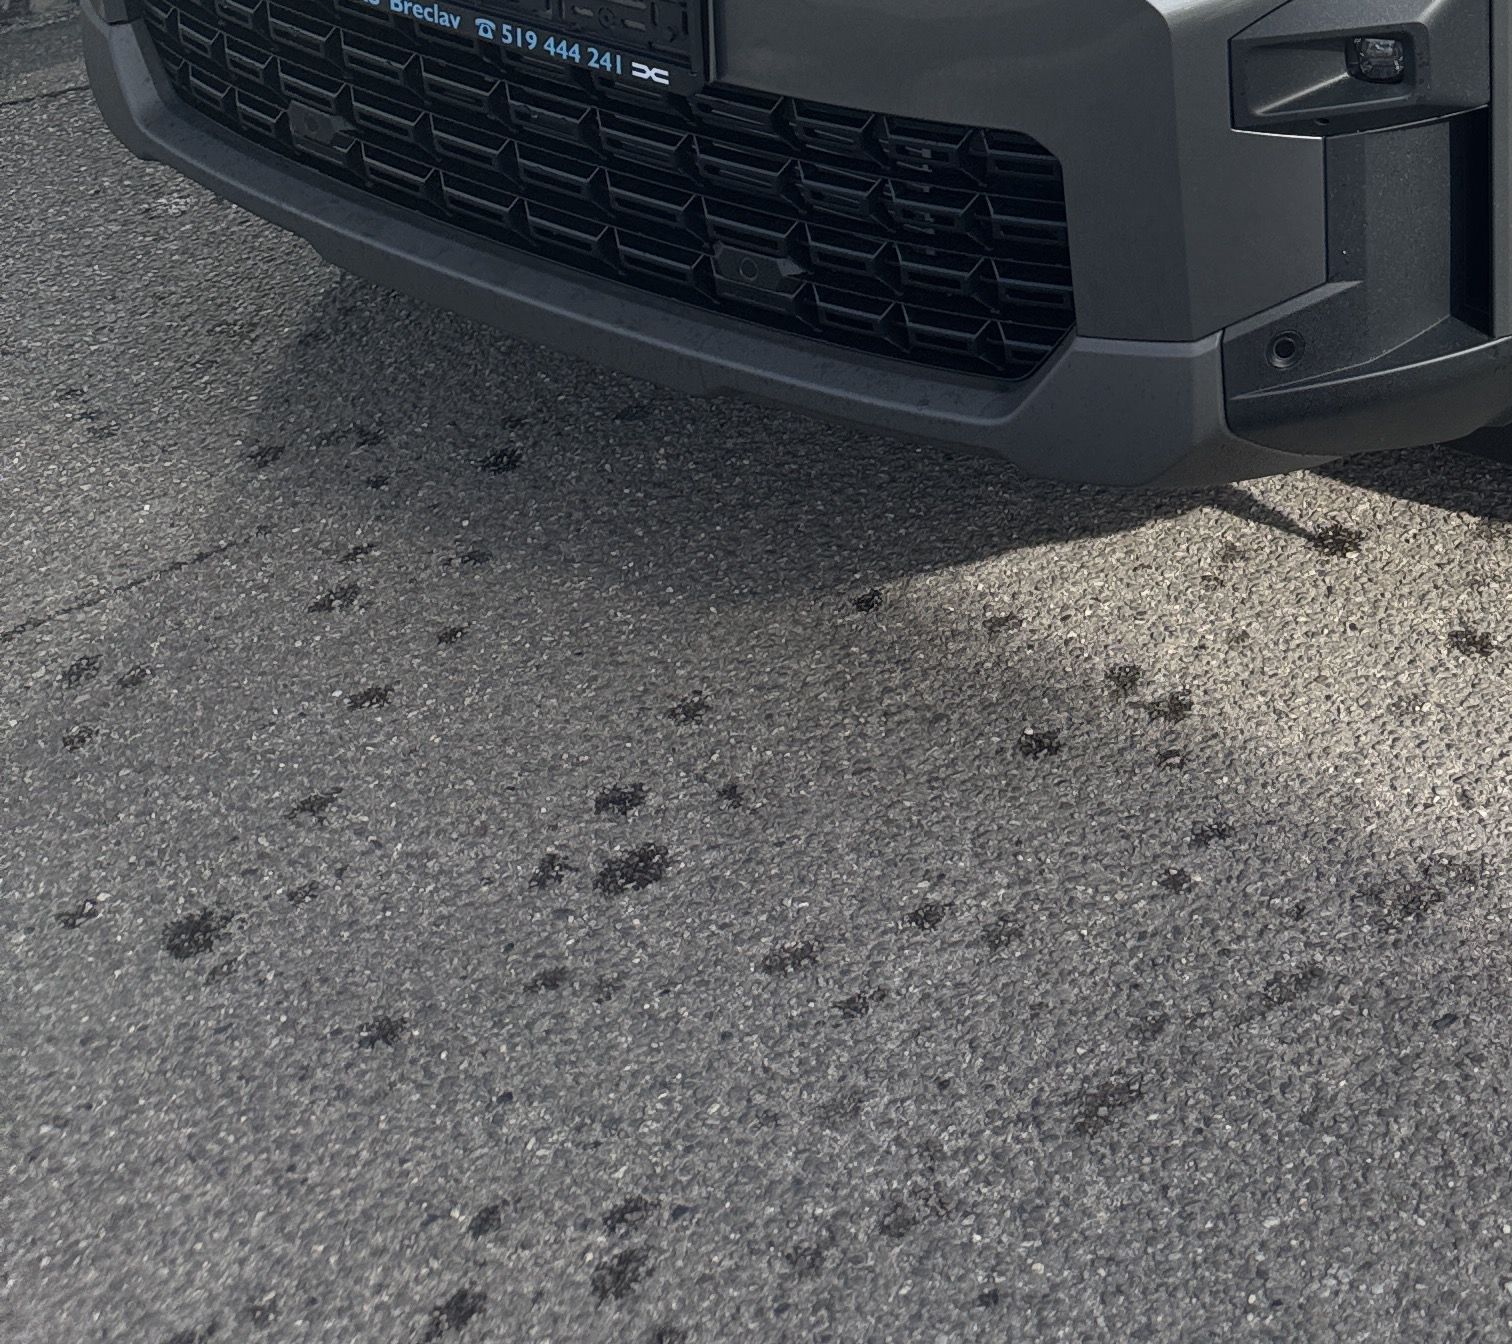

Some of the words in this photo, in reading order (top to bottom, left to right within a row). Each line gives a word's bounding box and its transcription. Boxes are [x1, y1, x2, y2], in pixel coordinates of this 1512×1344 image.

[501, 25, 538, 51] 519
[543, 36, 582, 64] 444
[587, 48, 623, 75] 241
